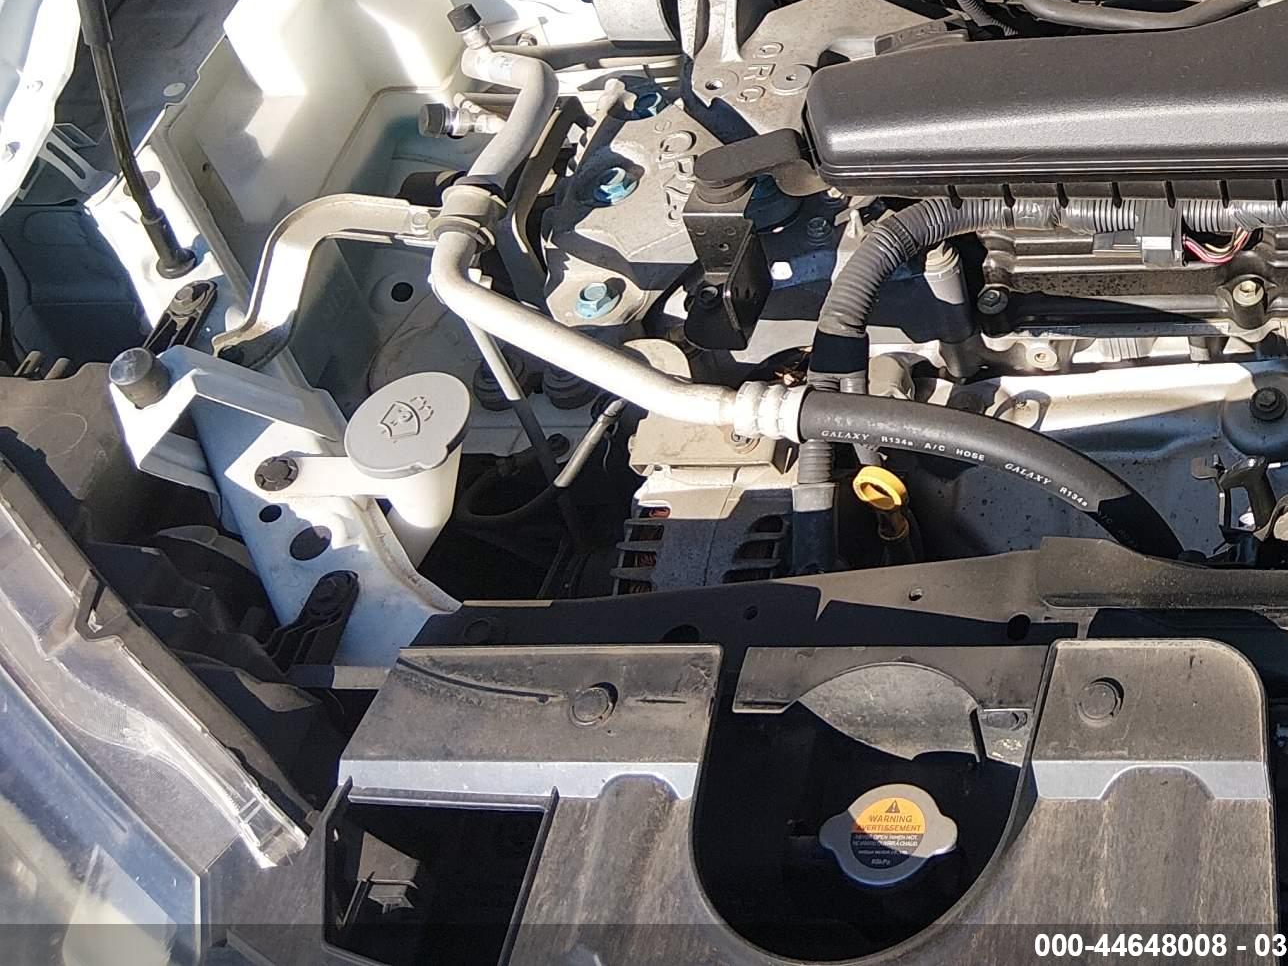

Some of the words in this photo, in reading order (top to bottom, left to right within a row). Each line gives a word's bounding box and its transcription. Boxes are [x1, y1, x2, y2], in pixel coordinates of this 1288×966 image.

[820, 429, 870, 442] GALAXY
[881, 434, 914, 447] R134a
[924, 441, 946, 453] A/C
[956, 448, 986, 462] HOSE
[1004, 460, 1053, 487] GALAXY
[1059, 485, 1089, 508] R134a
[869, 814, 913, 823] WARNING
[856, 824, 922, 832] AVERTISSEMENT
